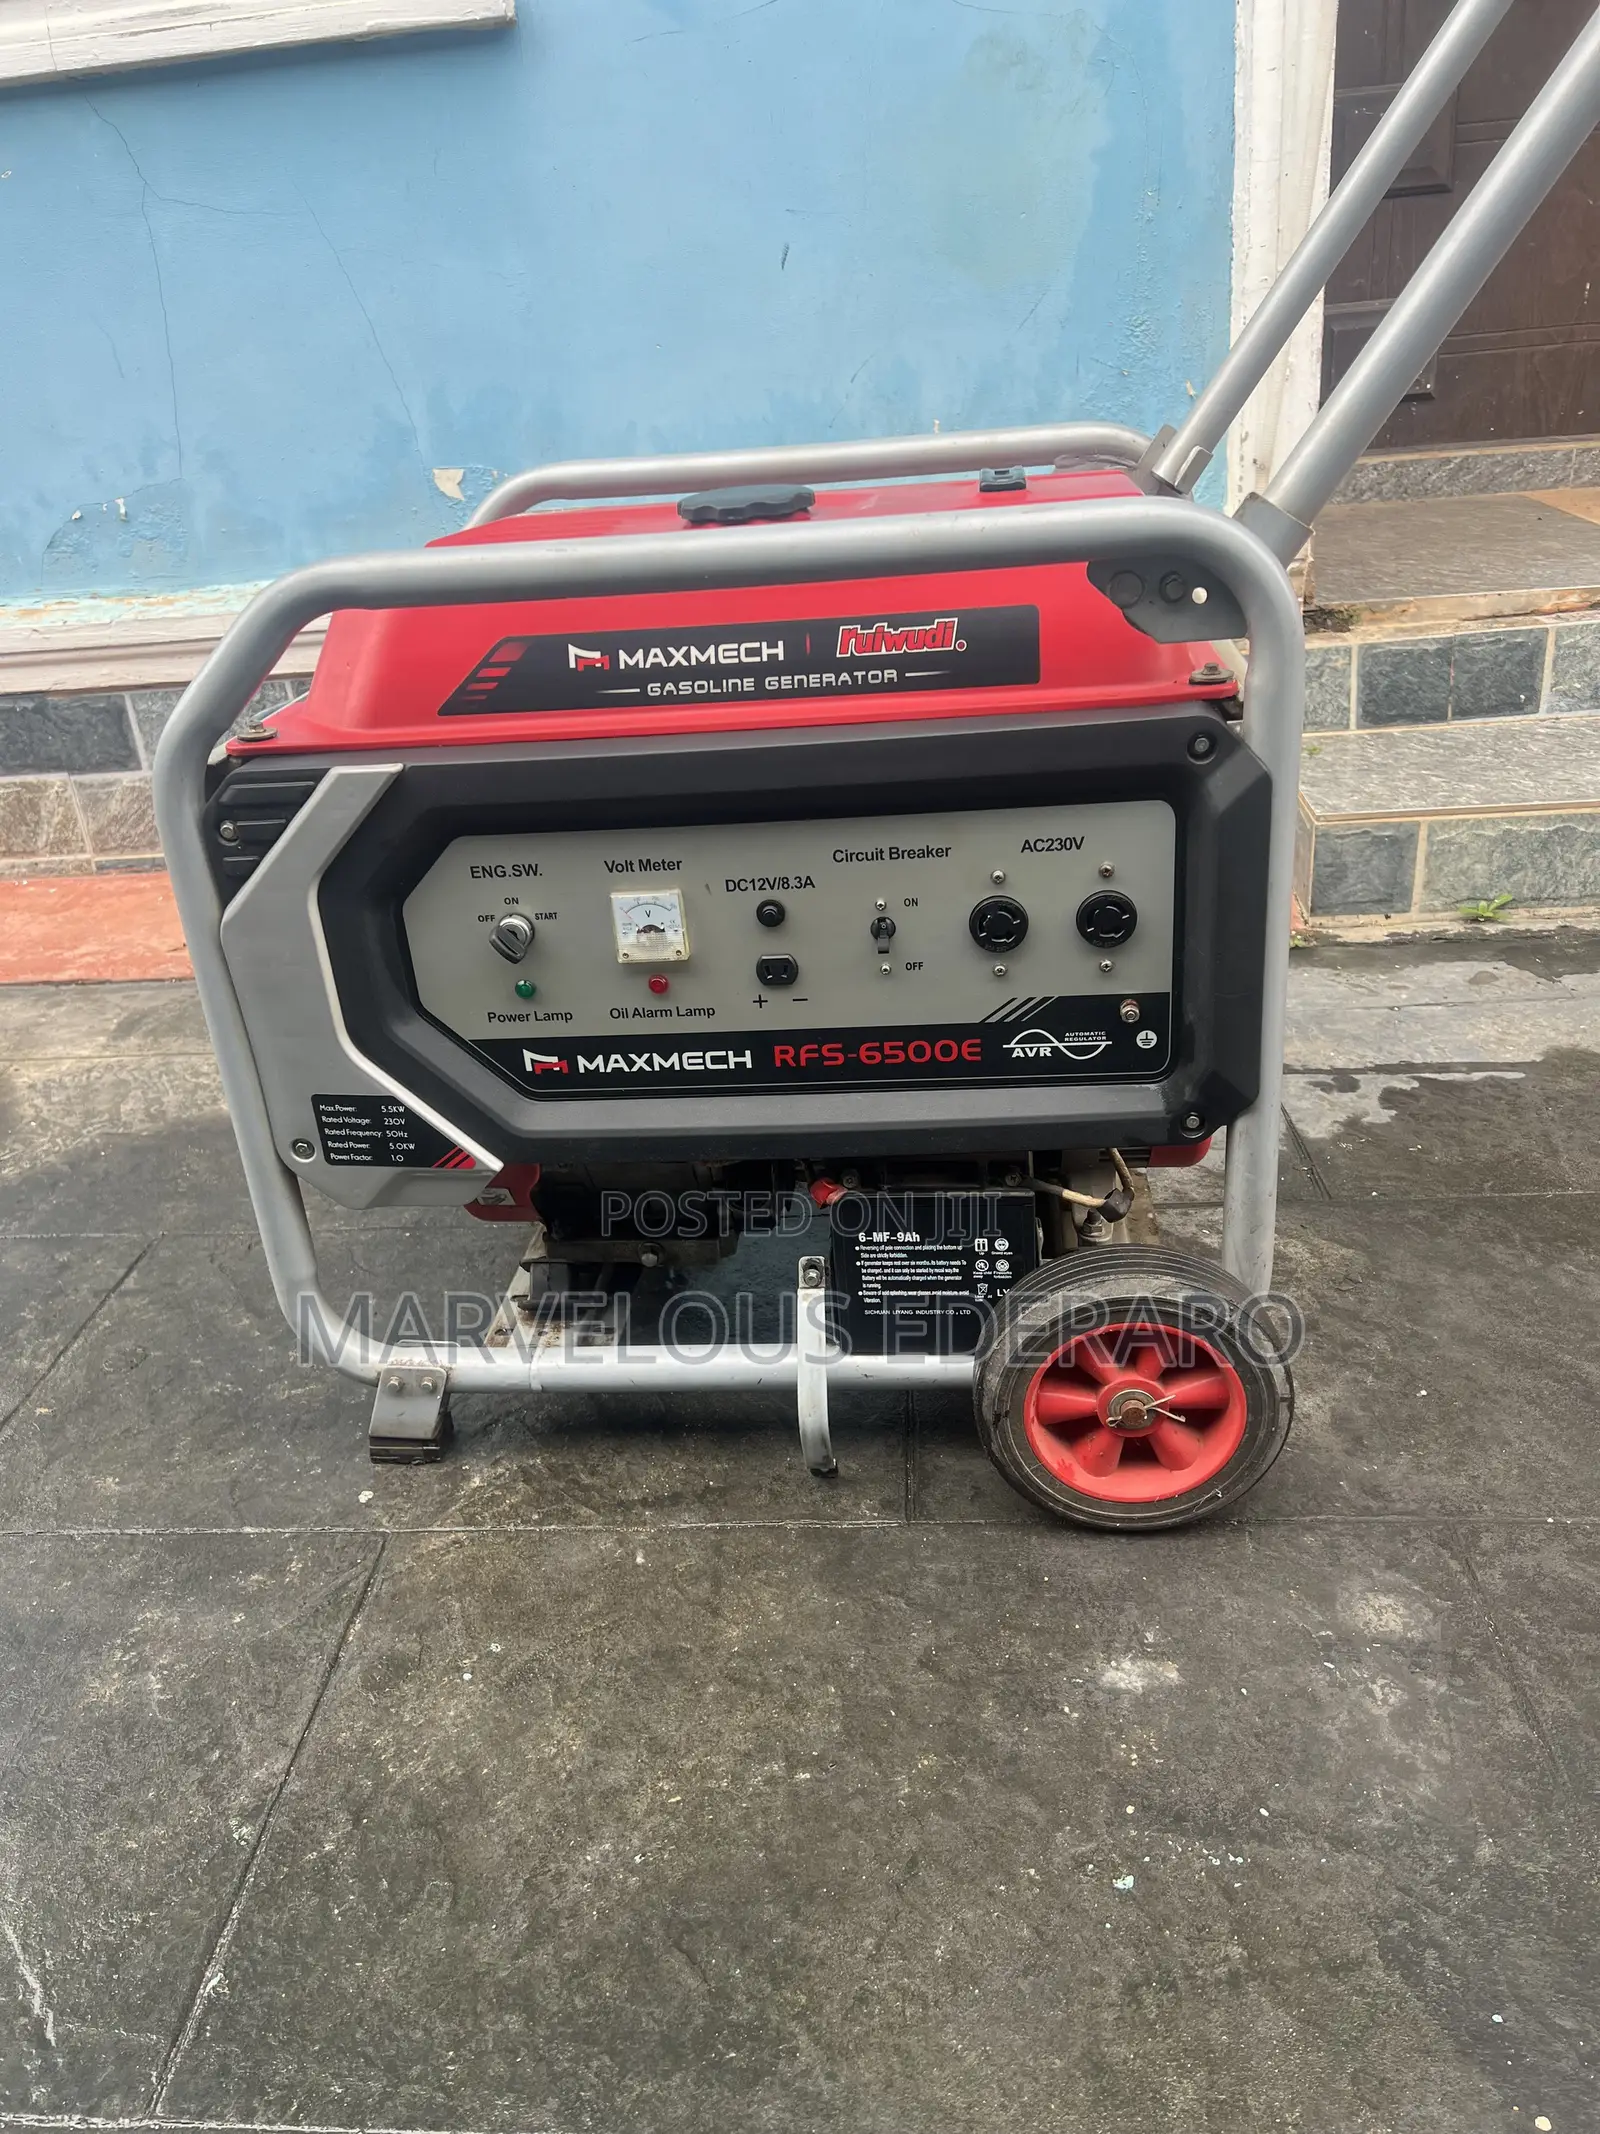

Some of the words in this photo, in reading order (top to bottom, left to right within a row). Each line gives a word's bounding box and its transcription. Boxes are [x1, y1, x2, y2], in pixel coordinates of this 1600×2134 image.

[618, 640, 785, 670] MAXMECH
[647, 676, 755, 697] GASOLINE
[765, 669, 898, 689] GENERATOR
[1020, 836, 1085, 853] AC230V
[832, 846, 885, 863] Circuit
[888, 844, 952, 861] Breaker
[470, 864, 543, 879] ENG.SW.
[604, 859, 635, 874] Volt
[638, 858, 682, 872] Meter
[725, 875, 815, 893] DC12V/8.3A
[504, 897, 519, 905] ON
[903, 897, 919, 907] ON
[478, 914, 496, 923] OFF
[534, 912, 557, 921] START
[644, 909, 651, 918] V
[905, 961, 924, 971] OFF
[487, 1010, 531, 1023] Power
[534, 1009, 573, 1023] Lamp
[609, 1007, 629, 1020] Oil
[631, 1007, 673, 1020] Alarm
[676, 1006, 715, 1020] Lamp
[774, 1039, 982, 1067] RFS-6500E
[1011, 1047, 1052, 1058] AVR
[578, 1049, 752, 1074] MAXMECH
[381, 1105, 405, 1113] 5.5KW
[322, 1115, 343, 1123] Rated
[383, 1118, 406, 1126] 230V
[324, 1128, 346, 1136] Rated
[386, 1130, 409, 1138] 50Hz
[327, 1140, 348, 1148] Rated
[389, 1142, 415, 1150] 5.0KW
[330, 1153, 350, 1161] Power
[391, 1154, 404, 1162] 1.0
[858, 1231, 920, 1243] 6-MF-9Ah
